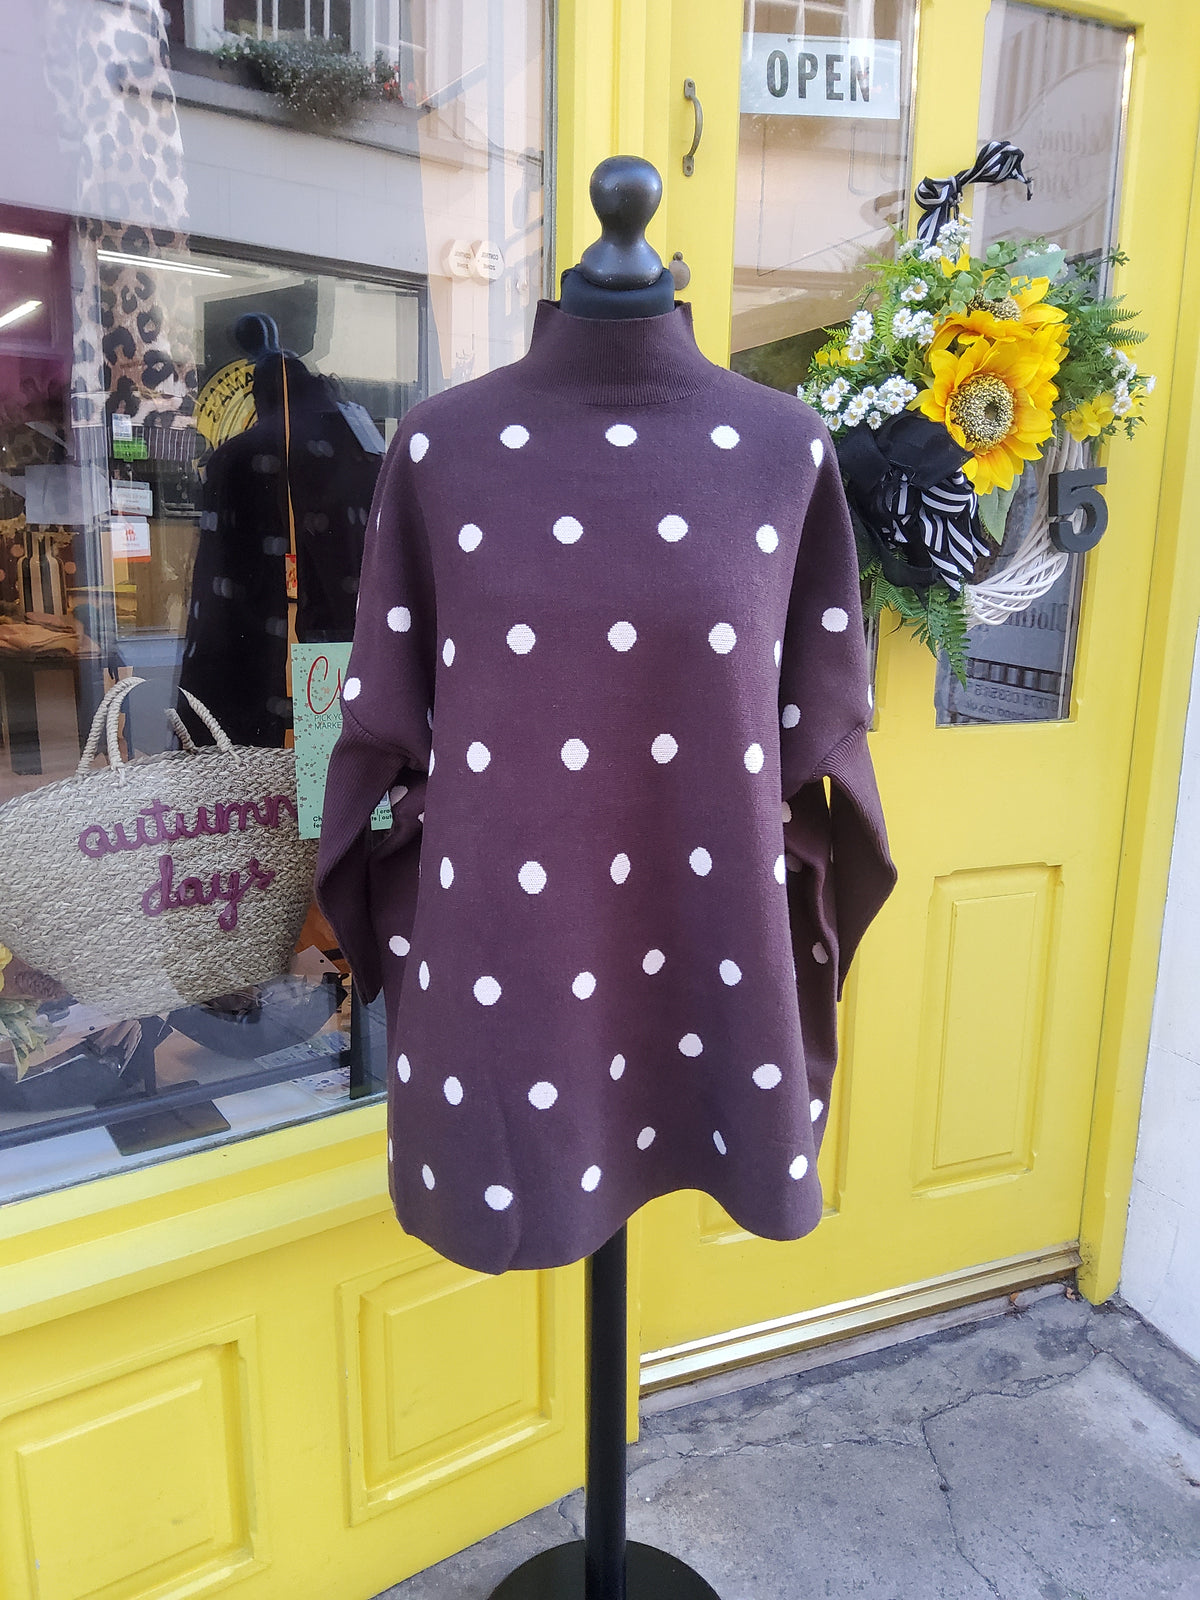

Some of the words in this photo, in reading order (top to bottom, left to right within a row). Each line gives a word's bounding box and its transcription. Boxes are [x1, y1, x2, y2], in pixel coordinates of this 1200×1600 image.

[766, 49, 870, 102] OPEN
[1048, 466, 1109, 553] 5
[314, 713, 332, 722] PICK
[78, 796, 298, 858] autumn
[142, 855, 276, 932] days
